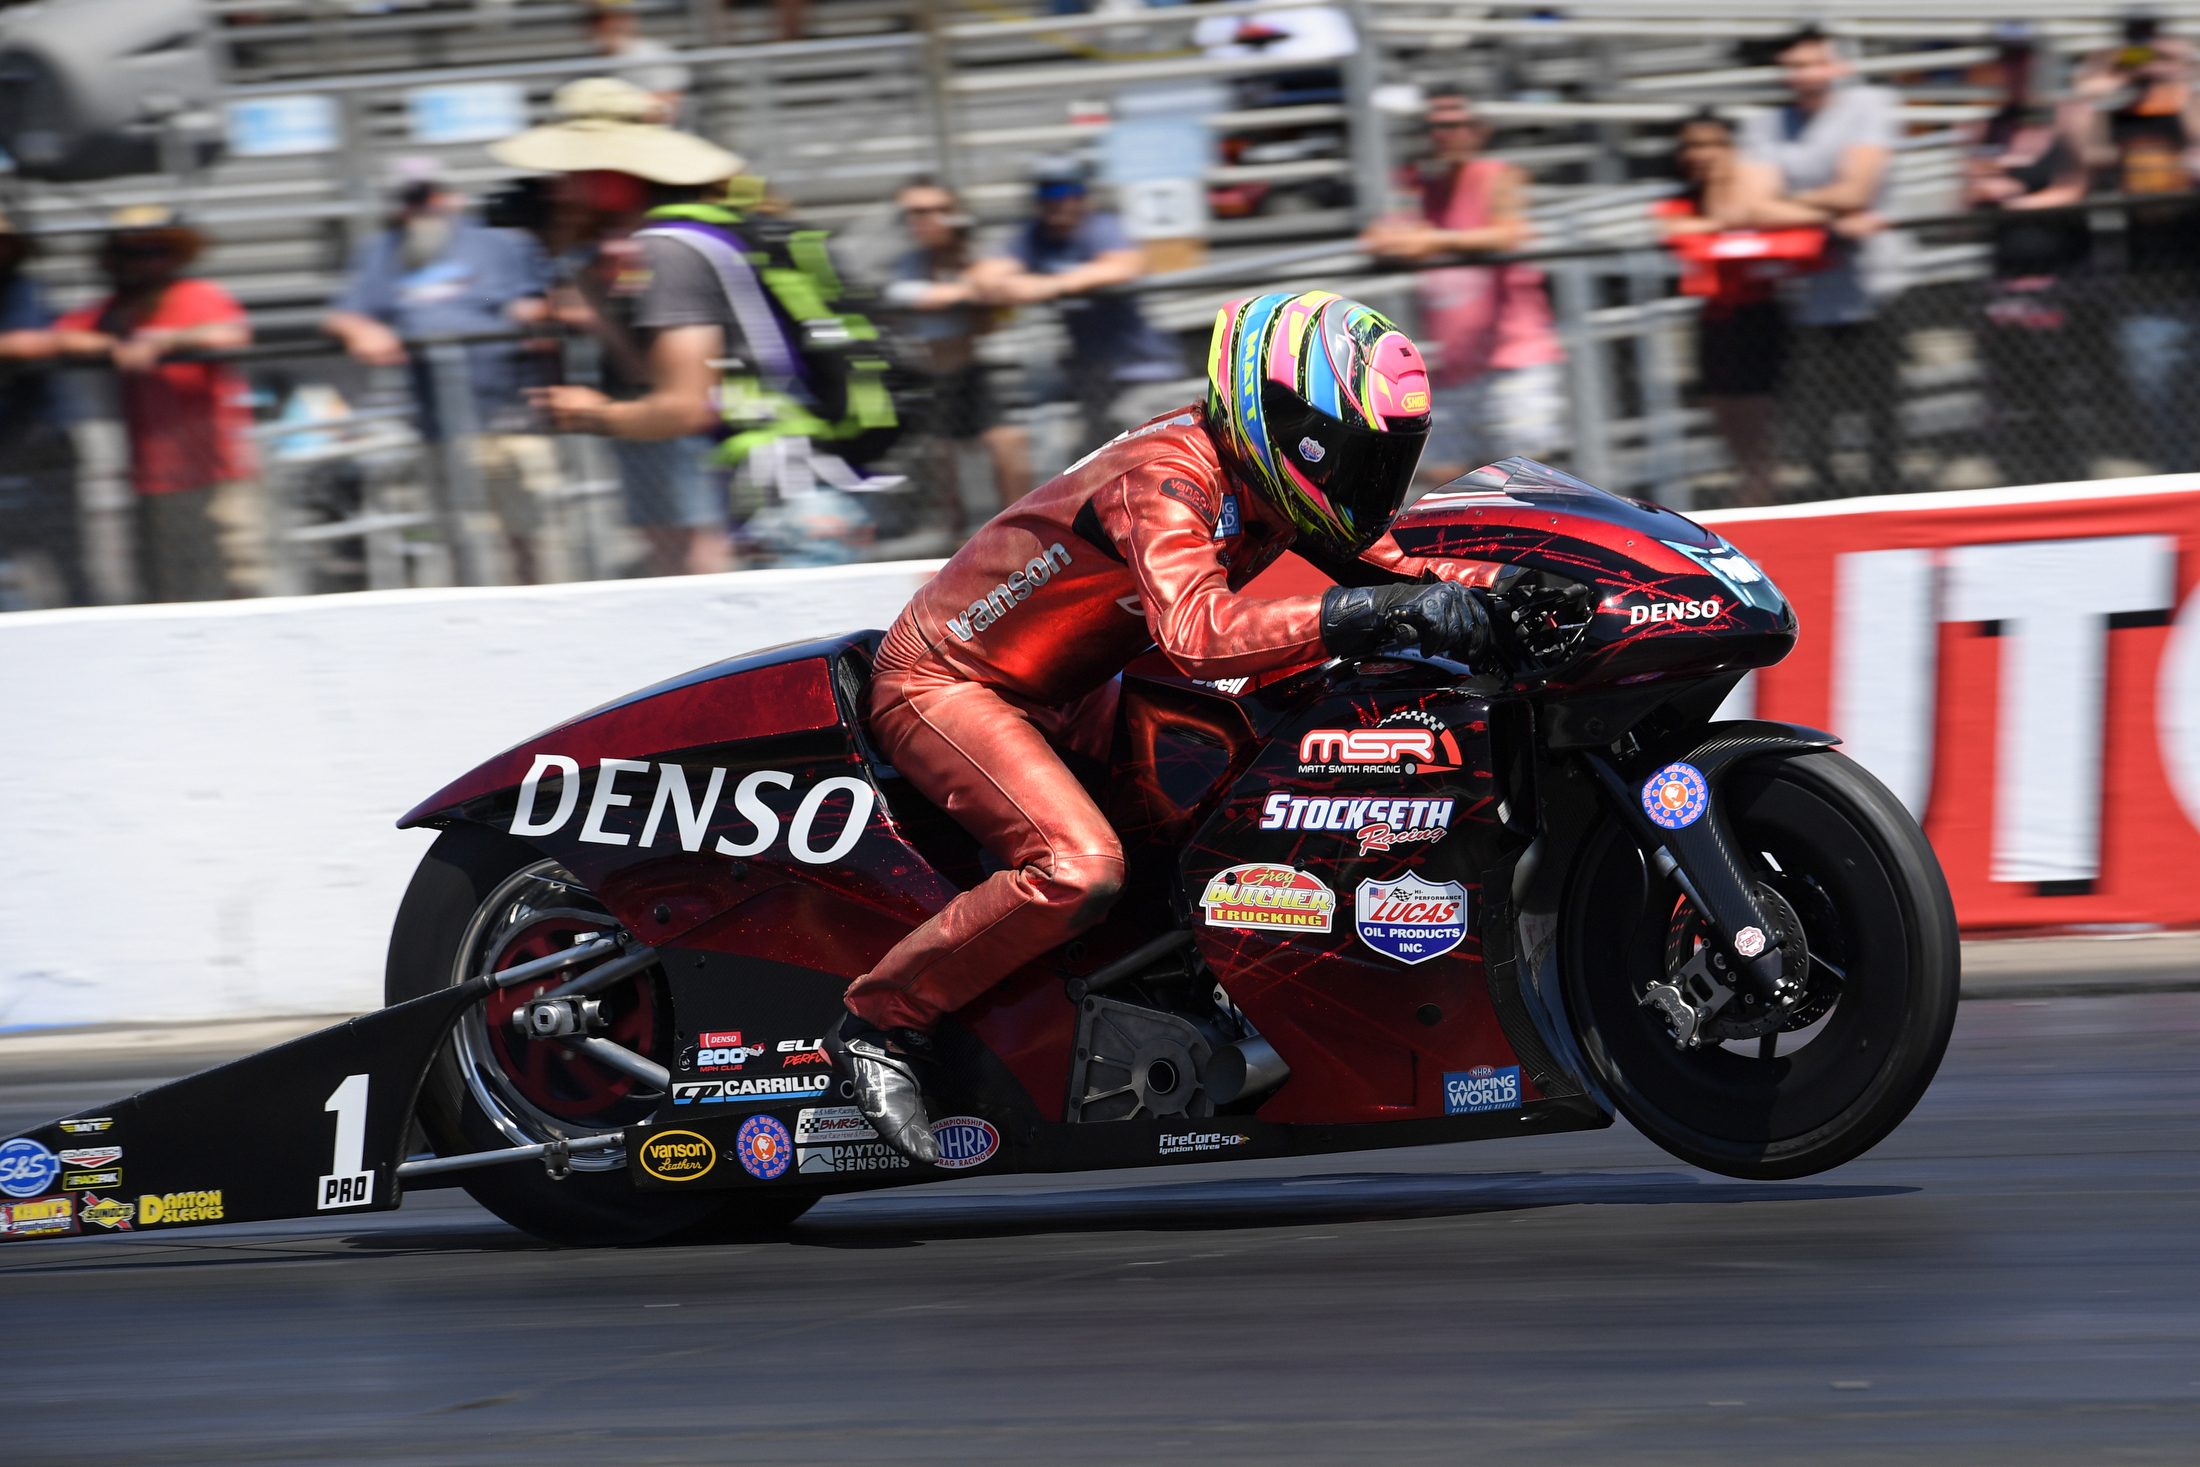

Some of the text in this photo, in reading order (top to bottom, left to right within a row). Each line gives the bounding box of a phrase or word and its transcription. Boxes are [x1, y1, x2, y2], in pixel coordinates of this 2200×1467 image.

[1243, 328, 1259, 421] MATT
[946, 542, 1072, 642] vanson
[1630, 600, 1720, 625] DENSO
[1301, 730, 1434, 762] MSR
[1298, 765, 1401, 774] MATT SMITH RACING
[508, 754, 875, 865] DENSO
[1260, 791, 1455, 831] STOCKSETH
[1357, 823, 1447, 856] Racing
[1240, 866, 1296, 887] Greg
[1207, 883, 1333, 910] BUTCHER
[1214, 909, 1322, 926] TRUCKING
[1369, 901, 1460, 923] LUCAS
[1363, 927, 1461, 939] OIL PRODUCTS
[1398, 942, 1426, 953] INC.
[711, 1035, 737, 1044] DENSO
[697, 1048, 746, 1066] 200
[720, 1064, 743, 1072] CLUB
[1472, 1067, 1492, 1077] NHRA
[725, 1074, 831, 1096] CARRILLO
[1447, 1074, 1516, 1093] CAMPING
[1448, 1087, 1517, 1106] WORLD
[325, 1074, 370, 1176] 1
[820, 1118, 860, 1130] BMRS
[650, 1143, 707, 1158] vanson
[933, 1126, 988, 1158] NHRA
[1159, 1143, 1220, 1155] Ignition Wires
[0, 1153, 47, 1181] S&S
[658, 1158, 703, 1171] Leathers
[835, 1156, 910, 1171] SENSORS
[936, 1153, 986, 1167] RAG RACING
[325, 1176, 368, 1205] PRO
[163, 1206, 224, 1223] SLEEVES
